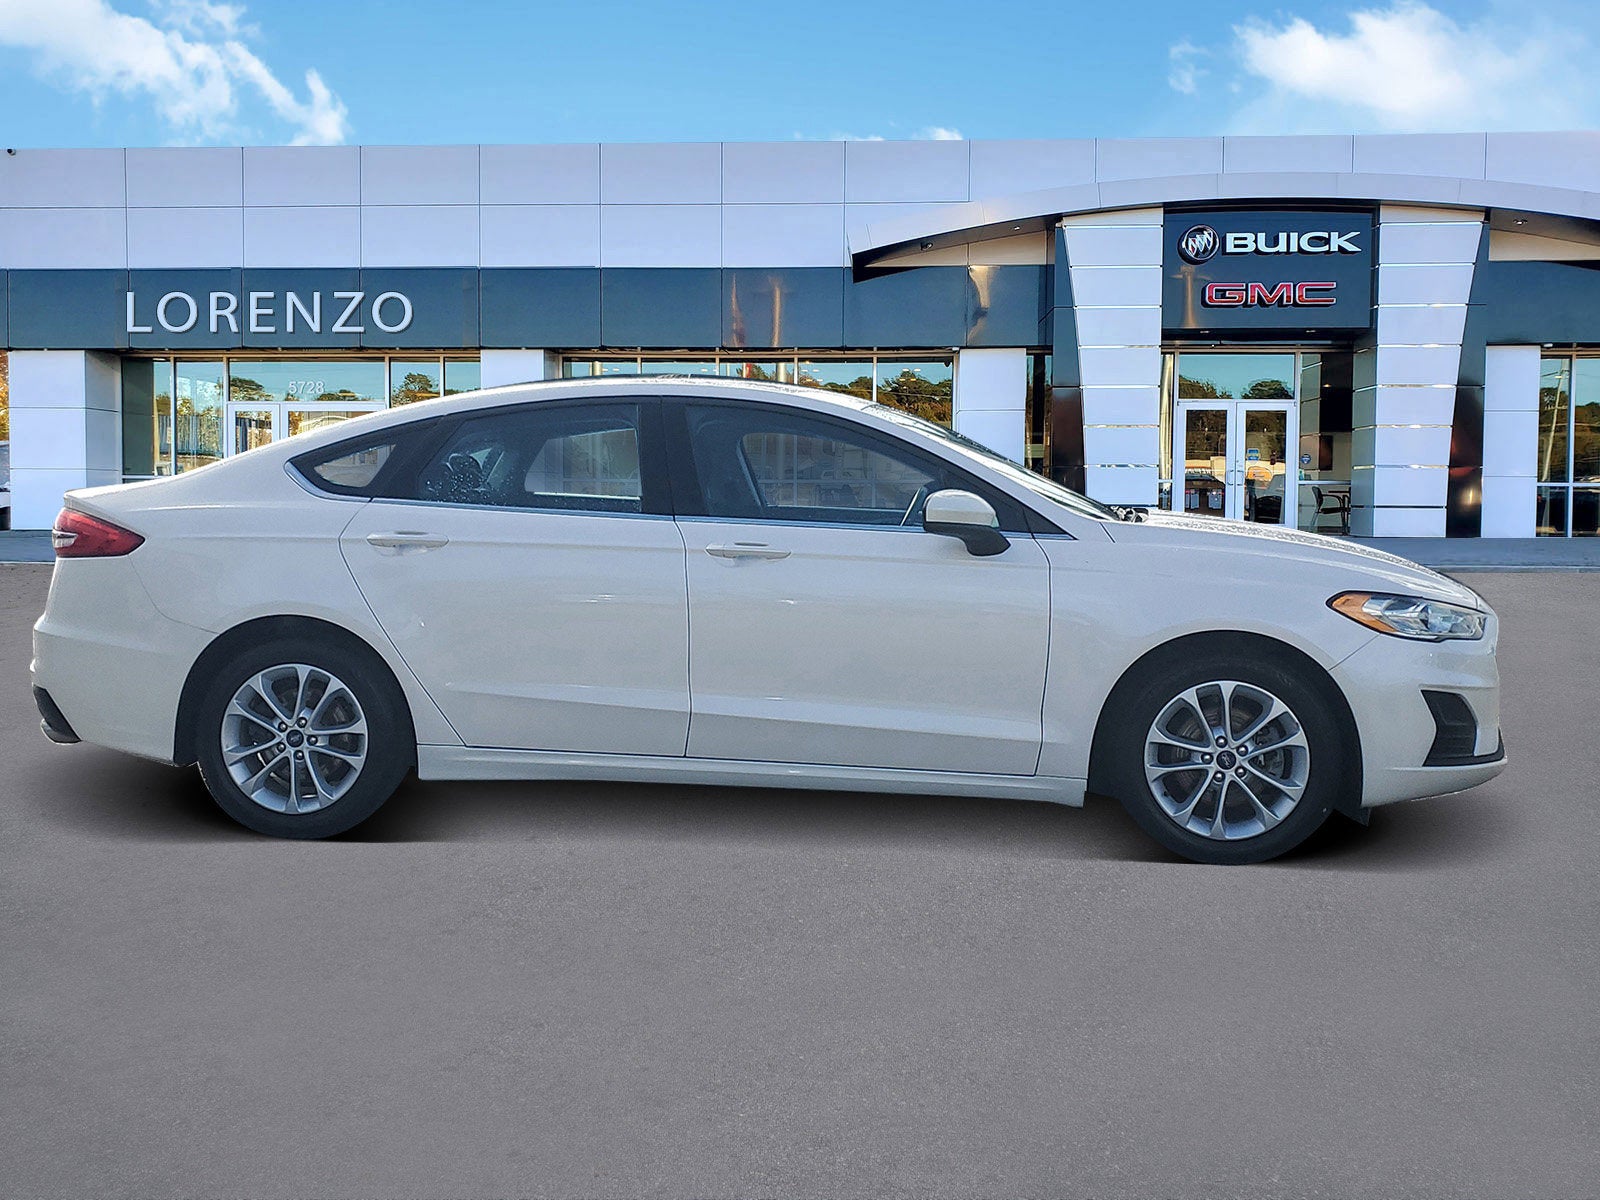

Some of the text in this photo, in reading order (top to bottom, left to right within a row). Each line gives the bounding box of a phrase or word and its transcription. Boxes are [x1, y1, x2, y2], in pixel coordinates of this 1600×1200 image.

[1225, 231, 1362, 253] BUICK
[1205, 281, 1337, 305] GMC
[126, 291, 412, 333] LORENZO
[288, 380, 325, 394] 5728
